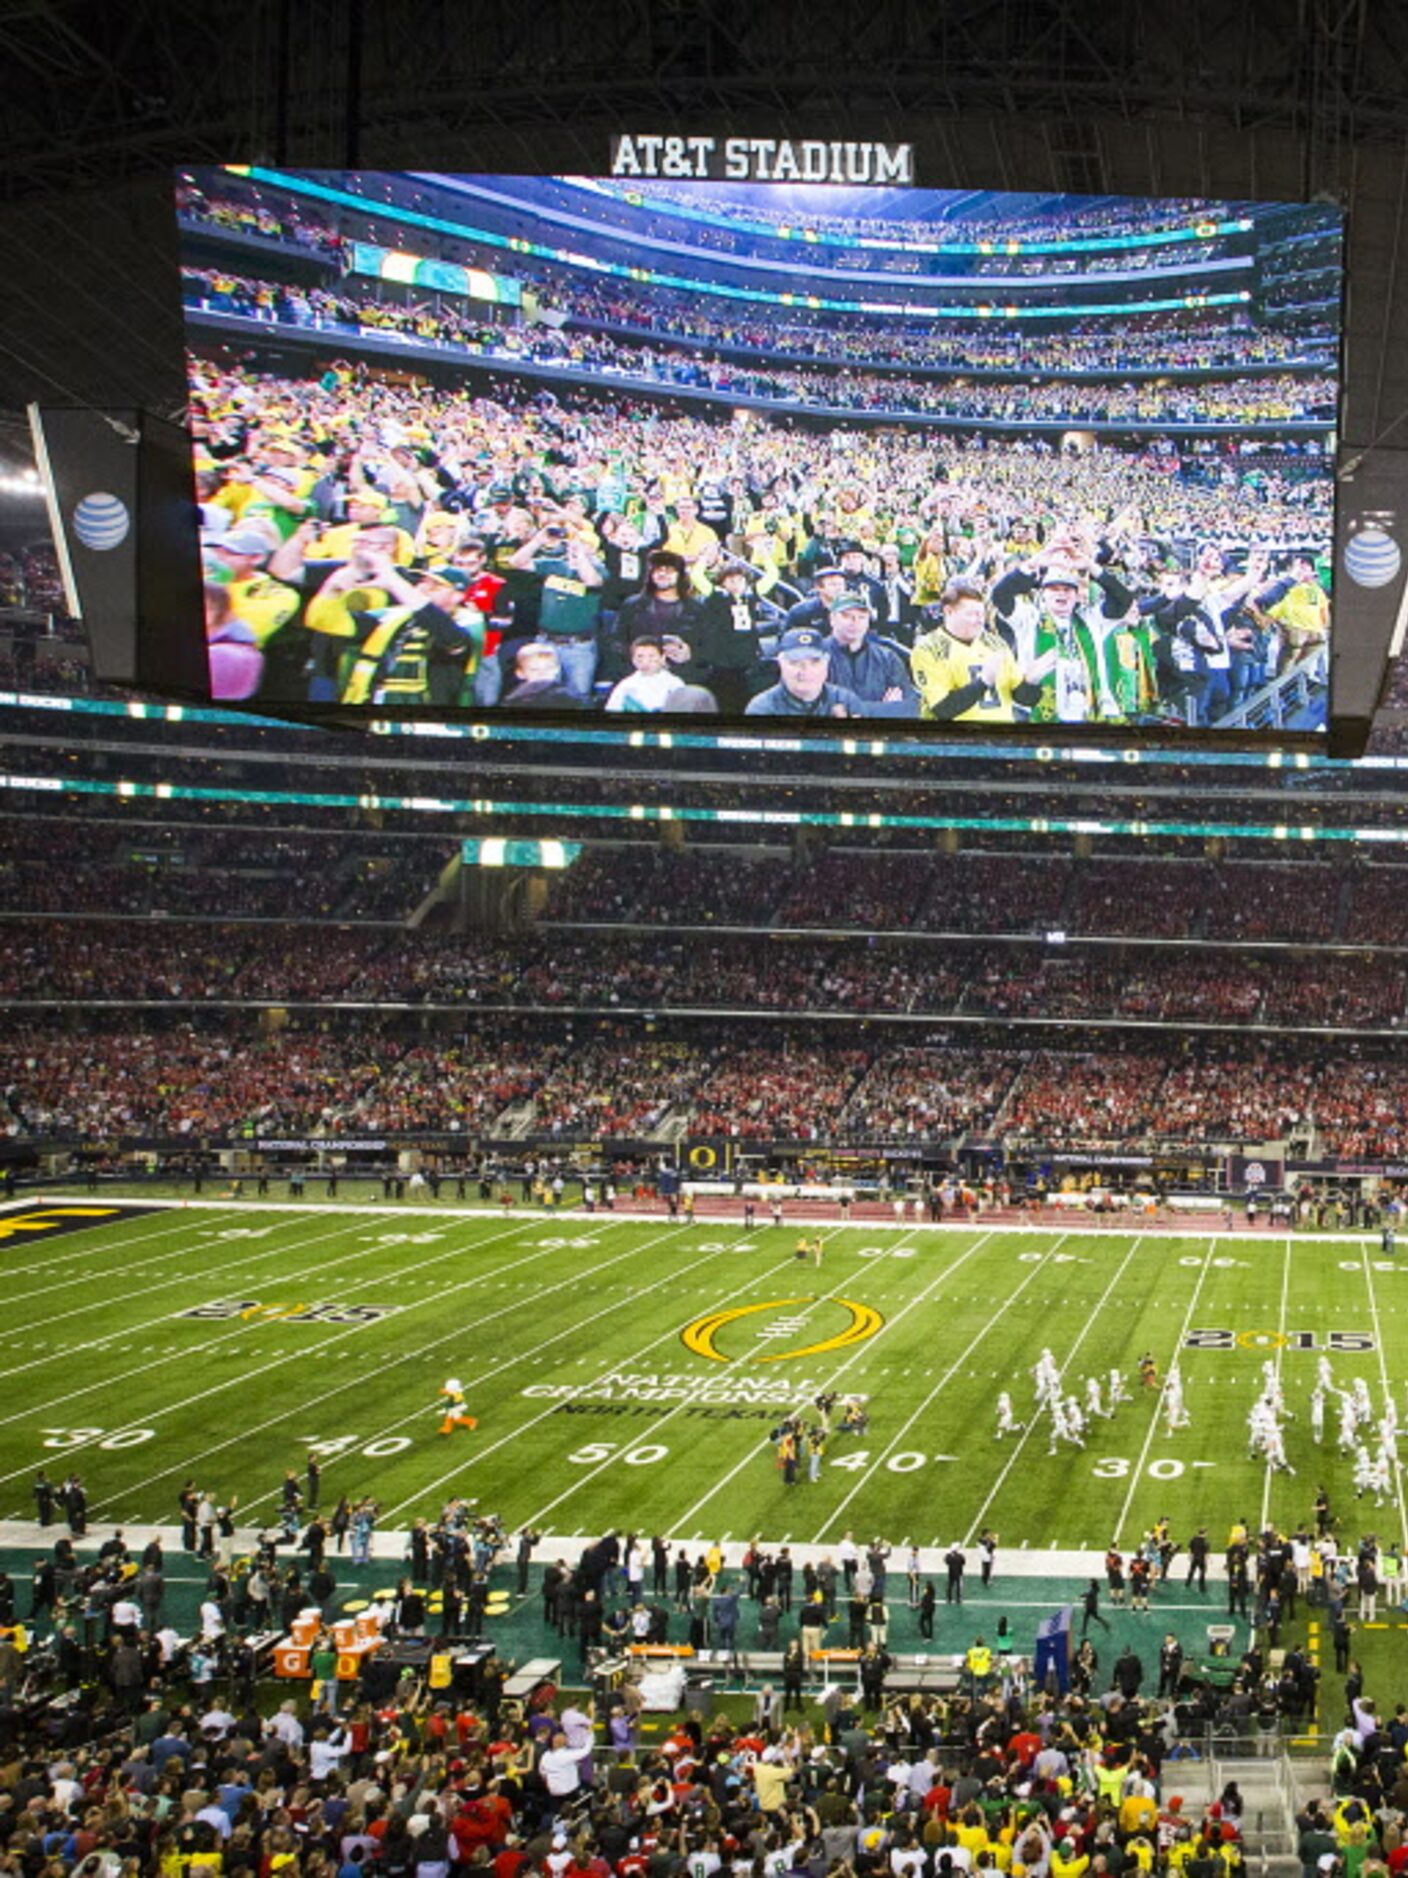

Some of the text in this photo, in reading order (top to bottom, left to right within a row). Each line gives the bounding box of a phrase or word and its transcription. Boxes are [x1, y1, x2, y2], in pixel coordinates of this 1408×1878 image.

[611, 134, 912, 183] AT&T STADIUM
[601, 1373, 823, 1392] NATIONAL
[43, 1427, 156, 1449] 30
[306, 1435, 412, 1457] 40
[567, 1442, 670, 1466] 50
[829, 1450, 927, 1473] 40
[1091, 1457, 1187, 1480] 30
